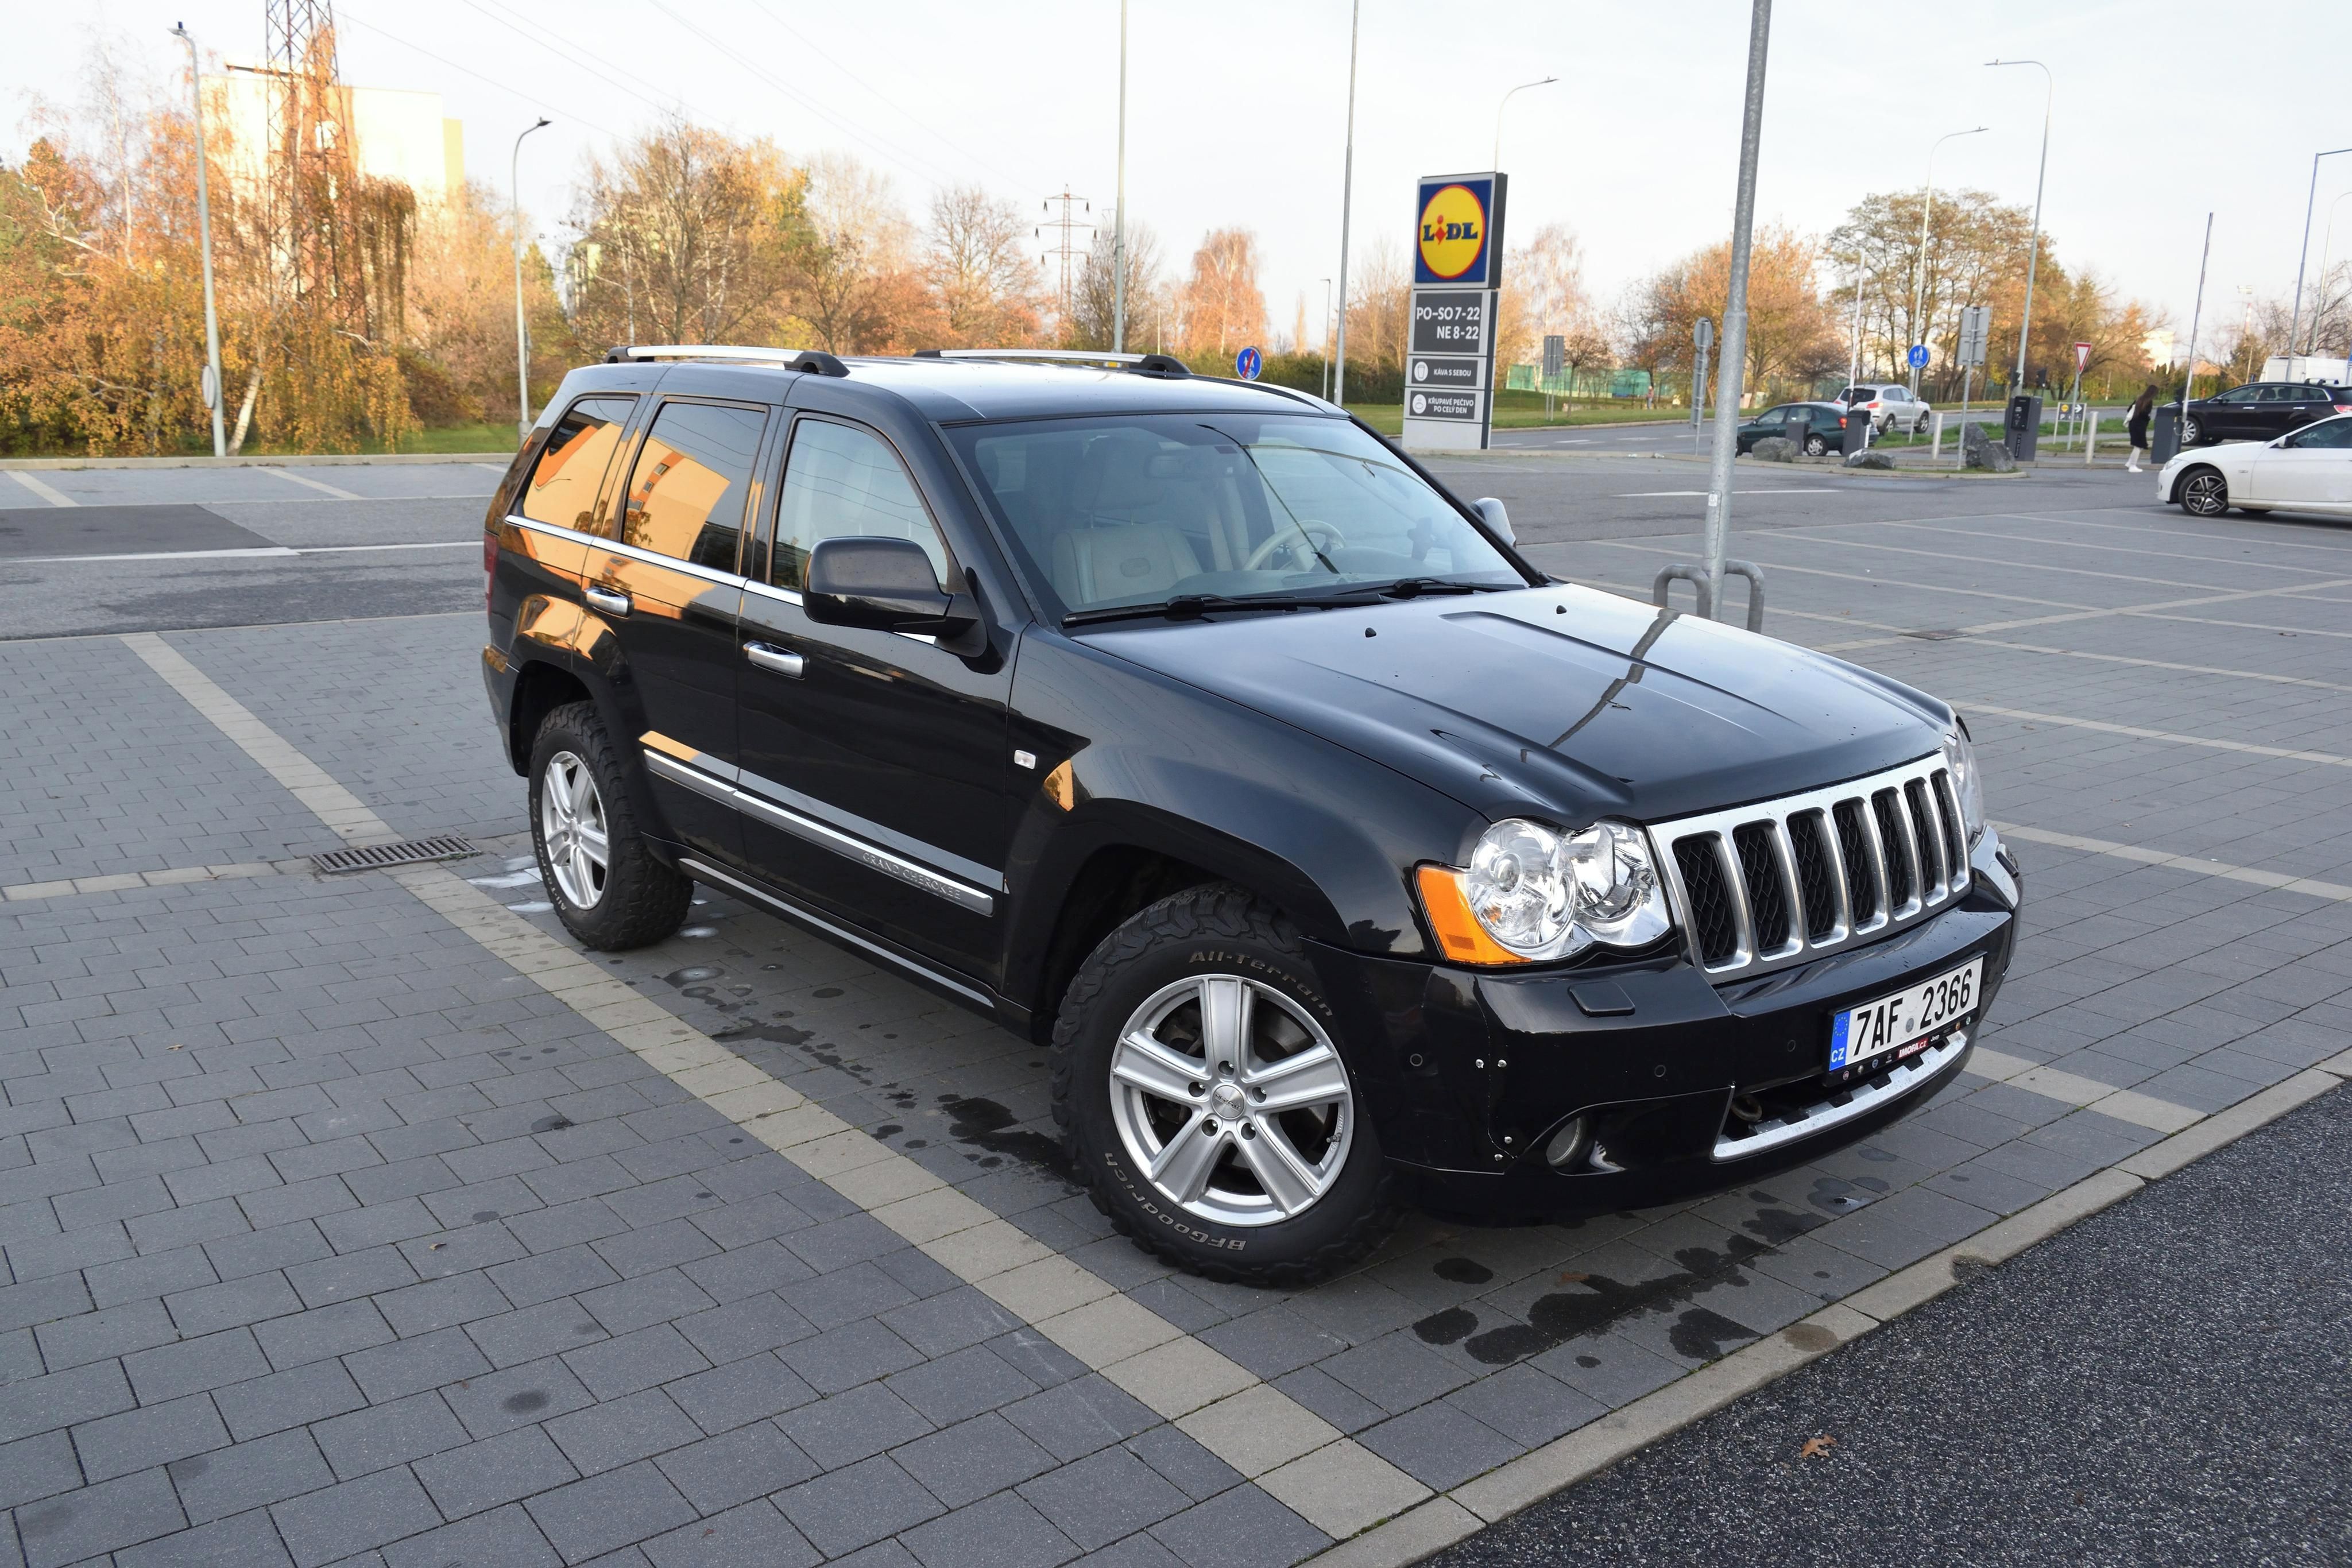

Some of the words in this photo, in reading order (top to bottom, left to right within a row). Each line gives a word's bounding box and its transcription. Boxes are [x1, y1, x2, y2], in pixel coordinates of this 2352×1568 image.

[1454, 307, 1480, 320] 7-22
[1437, 326, 1451, 339] NE
[1453, 326, 1479, 339] 8-22
[1428, 396, 1453, 405] KŘUPAVÉ
[1453, 398, 1474, 406] PEČIVO
[1442, 405, 1455, 413] CELÝ
[862, 853, 899, 874] GRAND
[903, 869, 961, 900] CHEROKEE
[1189, 950, 1333, 1017] All-Terrain
[1854, 997, 1904, 1056] 7AF
[1920, 968, 1972, 1029] 2366
[1831, 1047, 1845, 1063] CZ
[1104, 1152, 1247, 1251] BFGoodrich
